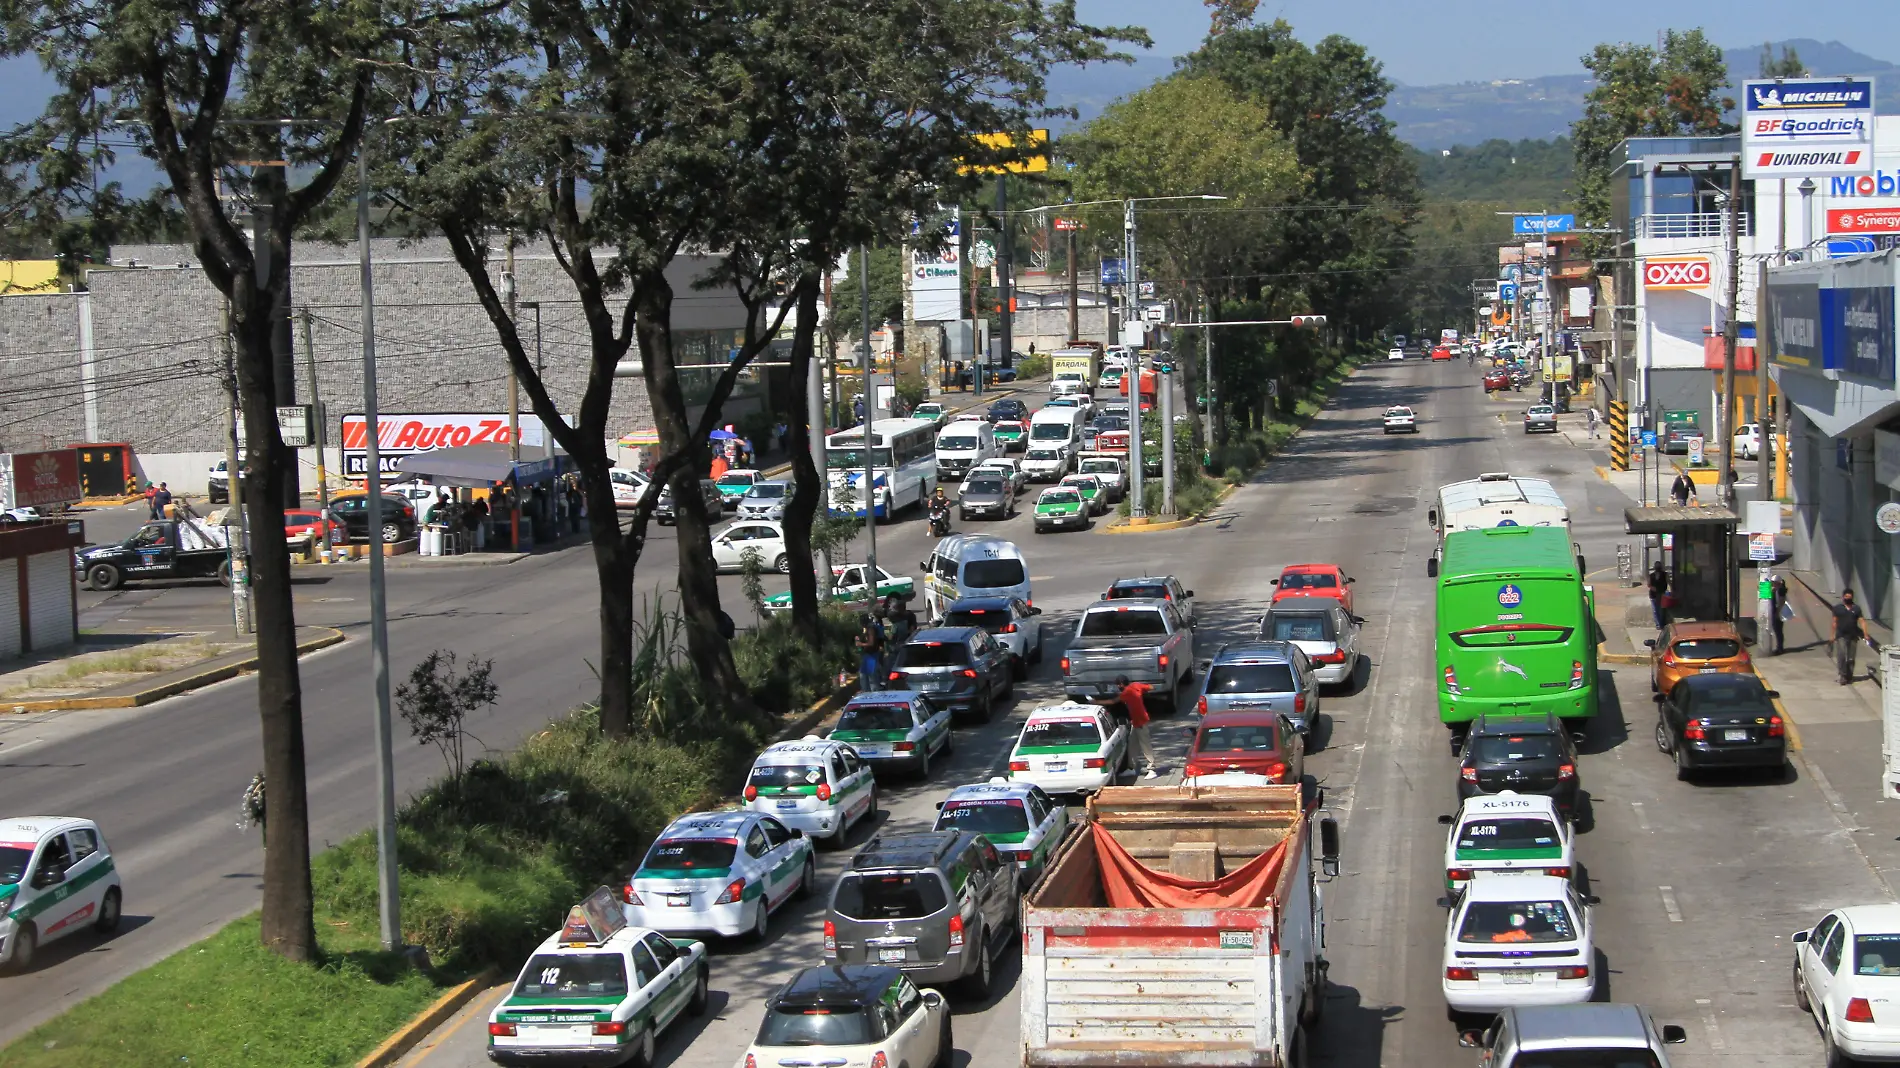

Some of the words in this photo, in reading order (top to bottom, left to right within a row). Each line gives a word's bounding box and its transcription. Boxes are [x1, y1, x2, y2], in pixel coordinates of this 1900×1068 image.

[1782, 91, 1863, 103] MICHELIN
[1755, 118, 1864, 133] BFGoodrich
[1773, 152, 1843, 166] UNIROYAL
[1647, 262, 1707, 285] OXXO
[1499, 593, 1520, 604] 622
[1026, 724, 1050, 732] XL-3172
[941, 809, 971, 819] XL-1573
[1470, 826, 1497, 836] XL-5176
[541, 968, 560, 985] 112
